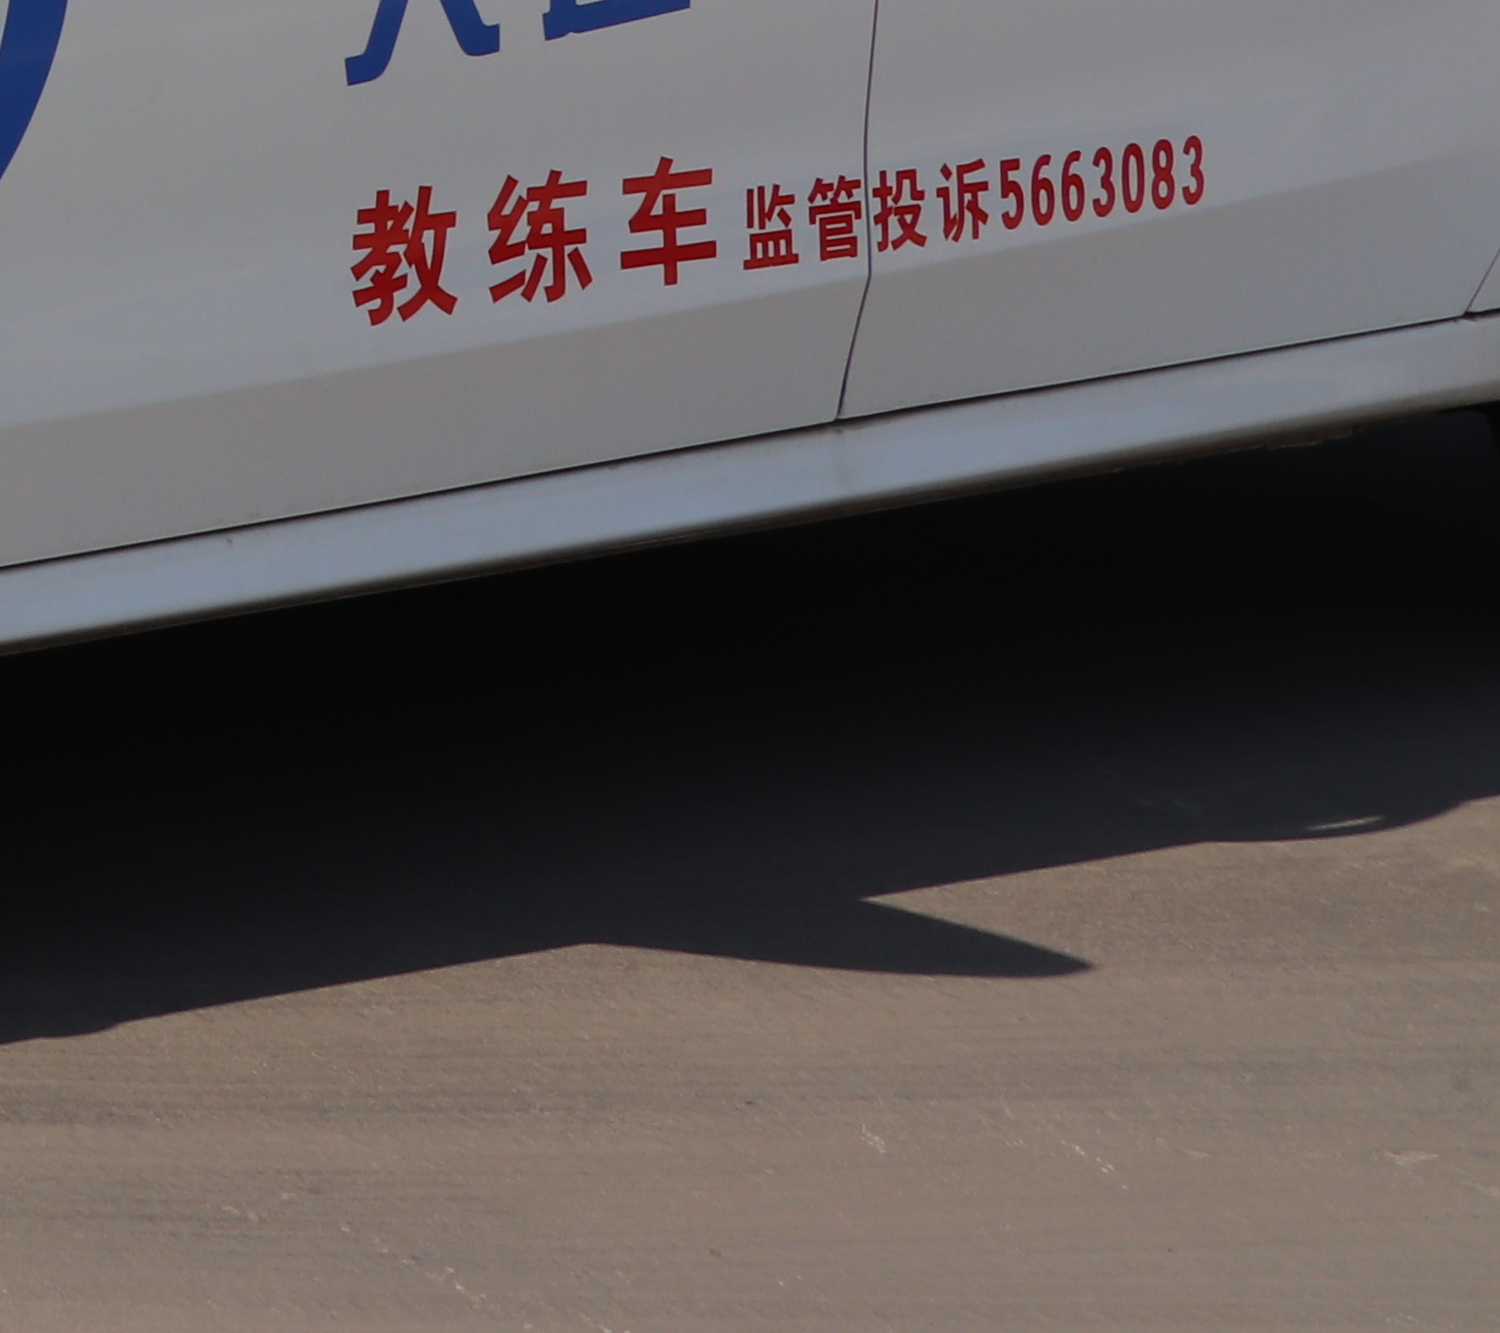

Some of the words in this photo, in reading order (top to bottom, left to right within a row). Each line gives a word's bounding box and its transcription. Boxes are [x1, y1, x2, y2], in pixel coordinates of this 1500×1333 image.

[350, 156, 718, 327] 教练车
[742, 134, 1207, 273] 监管投诉5663083
